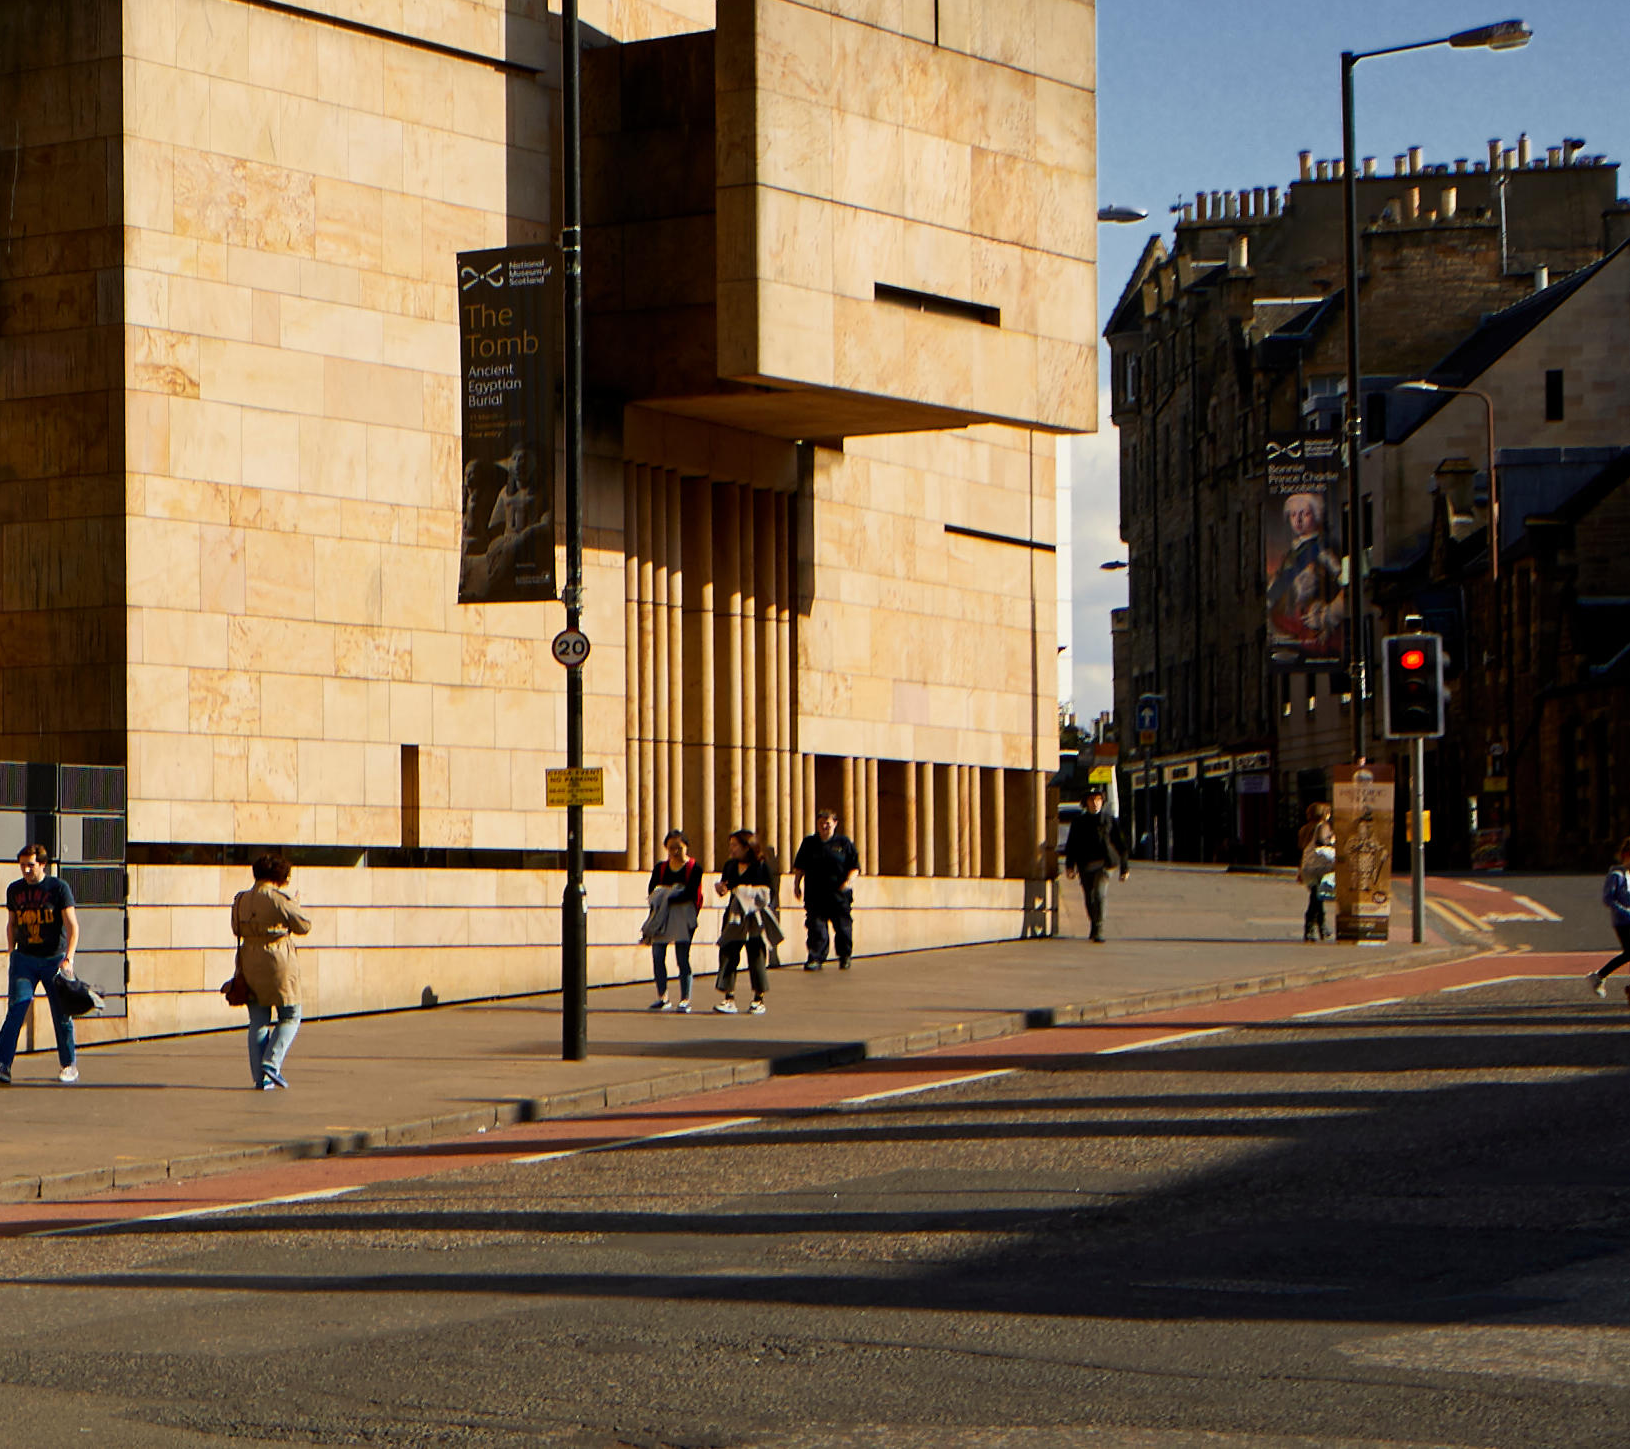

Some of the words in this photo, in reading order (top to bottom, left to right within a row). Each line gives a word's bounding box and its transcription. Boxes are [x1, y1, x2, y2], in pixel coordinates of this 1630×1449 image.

[464, 303, 514, 329] The
[465, 329, 539, 358] Tomb
[468, 363, 514, 378] Ancient
[468, 377, 522, 395] Egyptian
[468, 393, 503, 408] Burial
[558, 640, 585, 656] 20
